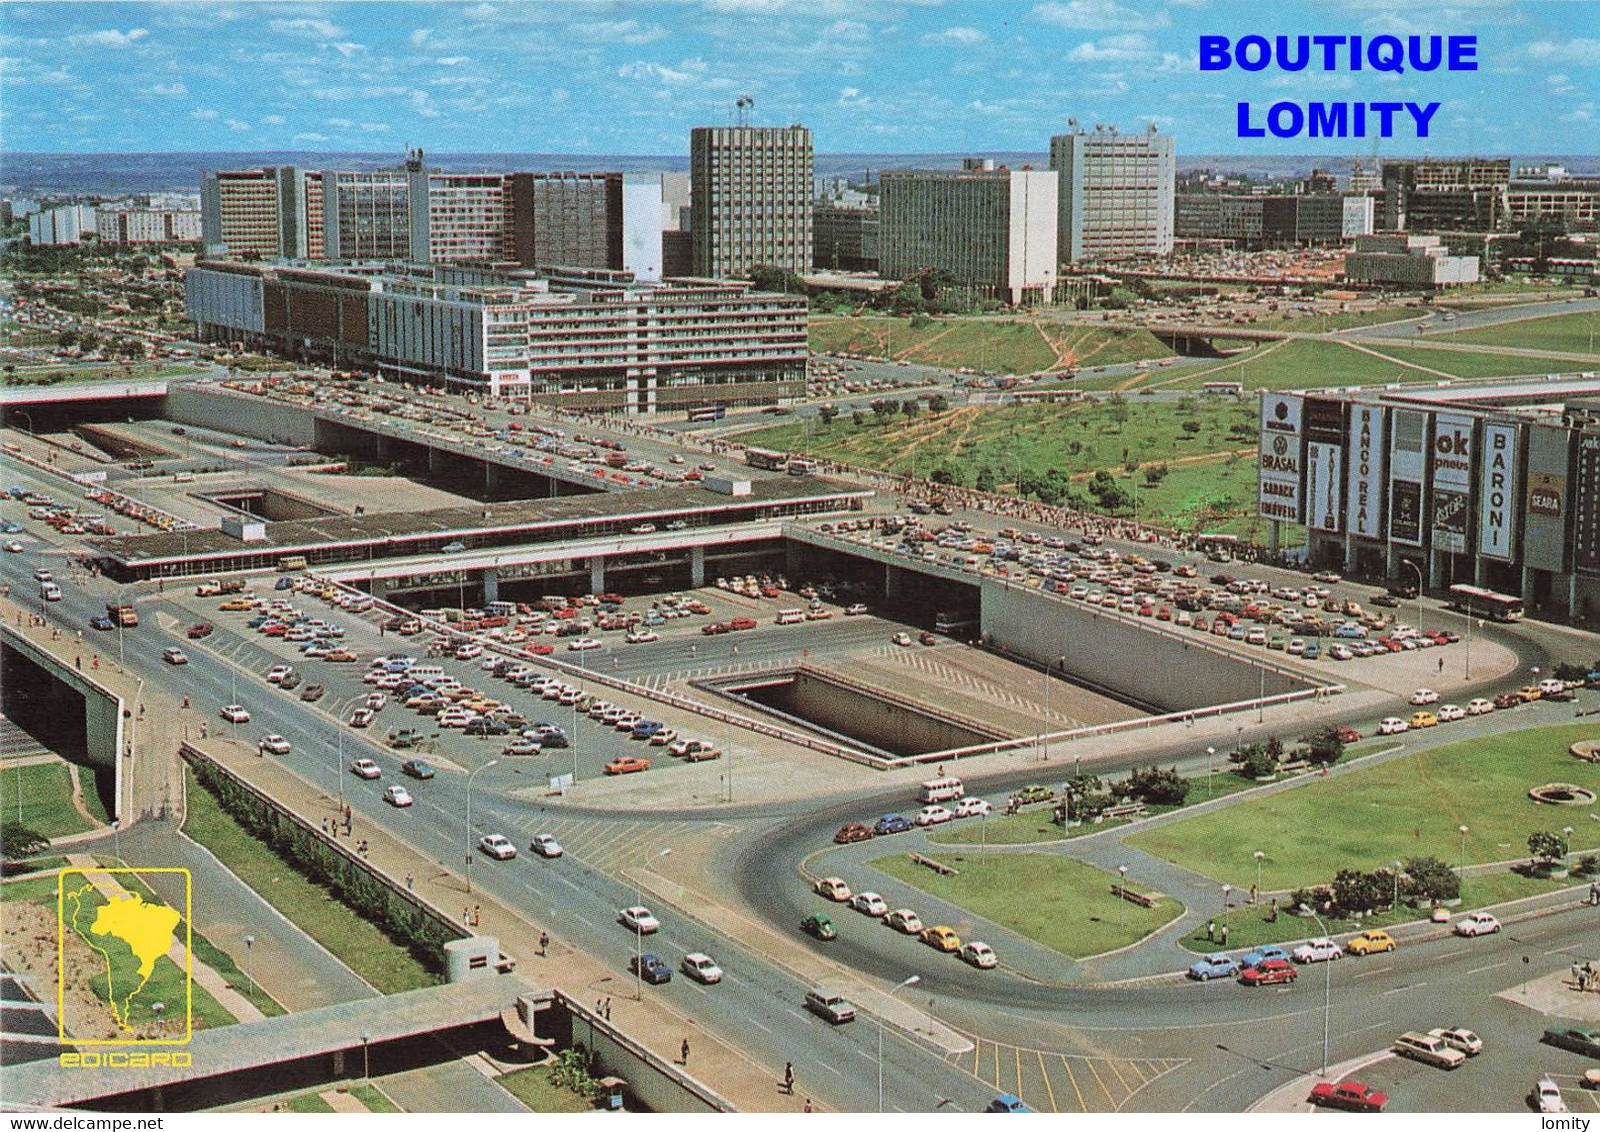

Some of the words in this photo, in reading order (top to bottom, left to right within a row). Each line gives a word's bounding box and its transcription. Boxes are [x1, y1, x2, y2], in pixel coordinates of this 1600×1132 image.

[1262, 454, 1298, 473] BRASAL
[1360, 410, 1371, 476] BANCO
[1358, 480, 1368, 533] REAL
[1489, 434, 1506, 546] BARONI
[1531, 494, 1558, 510] SEARA
